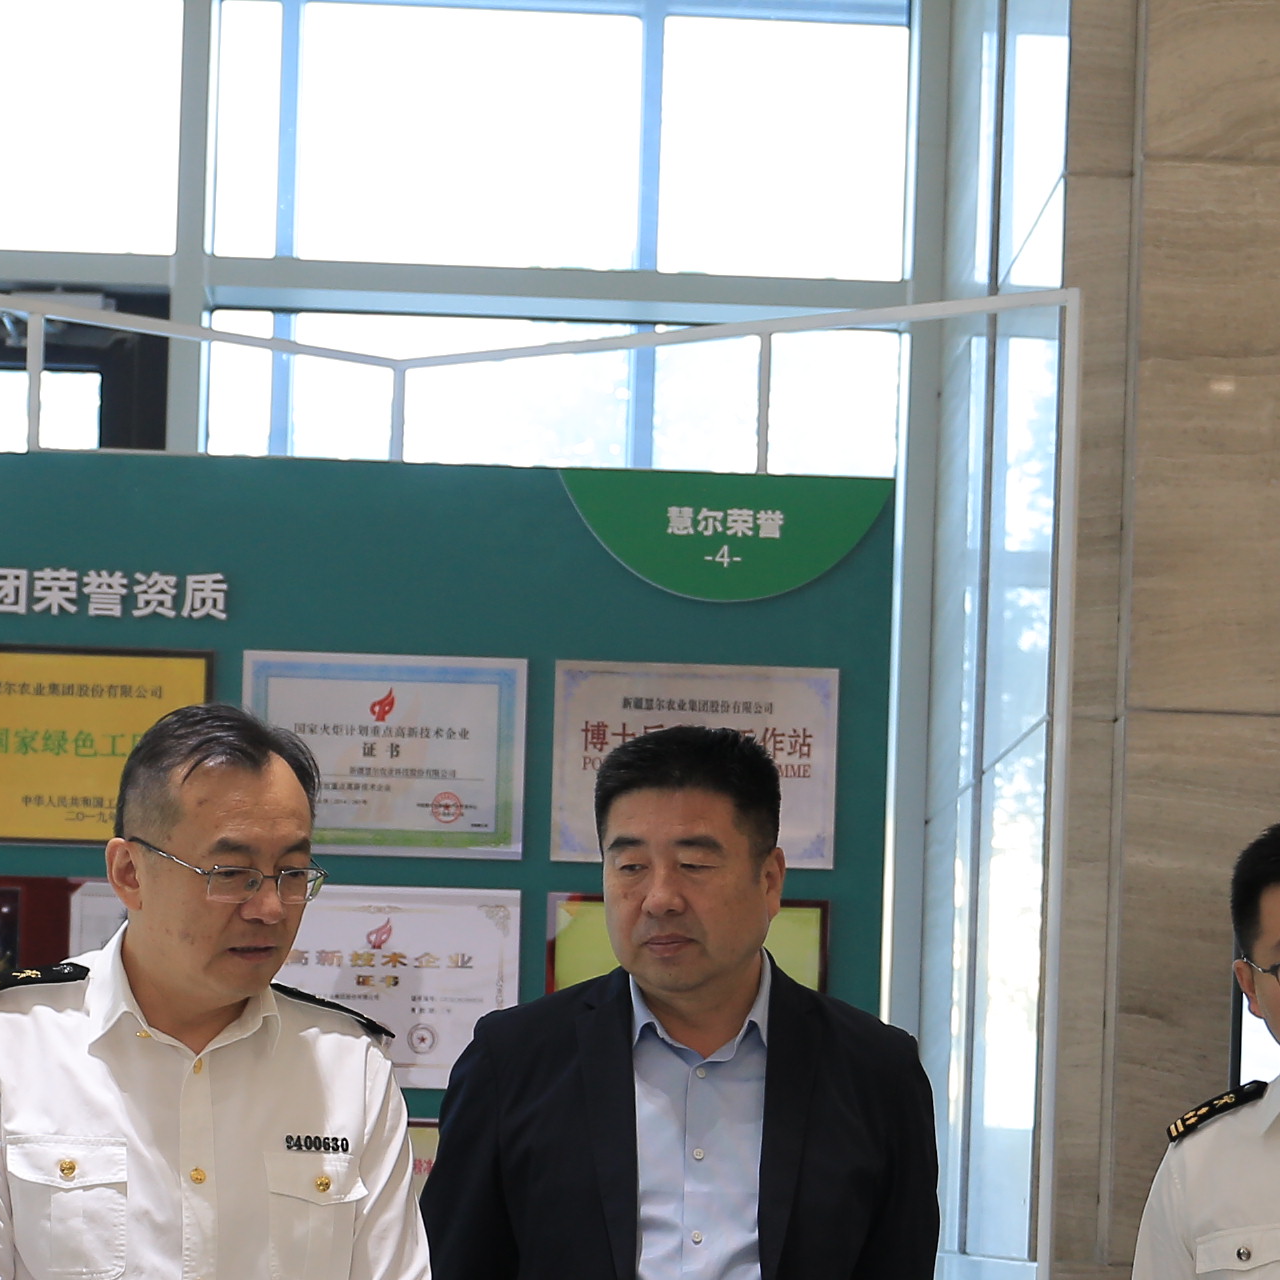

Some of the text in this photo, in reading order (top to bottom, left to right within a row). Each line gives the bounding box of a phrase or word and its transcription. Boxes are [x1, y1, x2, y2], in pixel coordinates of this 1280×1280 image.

[666, 506, 784, 539] 慧尔荣誉
[704, 544, 742, 568] -4-
[622, 696, 774, 715] 新疆慧尔农业集团股份有限公司
[294, 722, 470, 741] 国家火炬计划重点高新技术企业
[362, 742, 401, 758] 证书
[285, 1134, 349, 1152] 9400630
